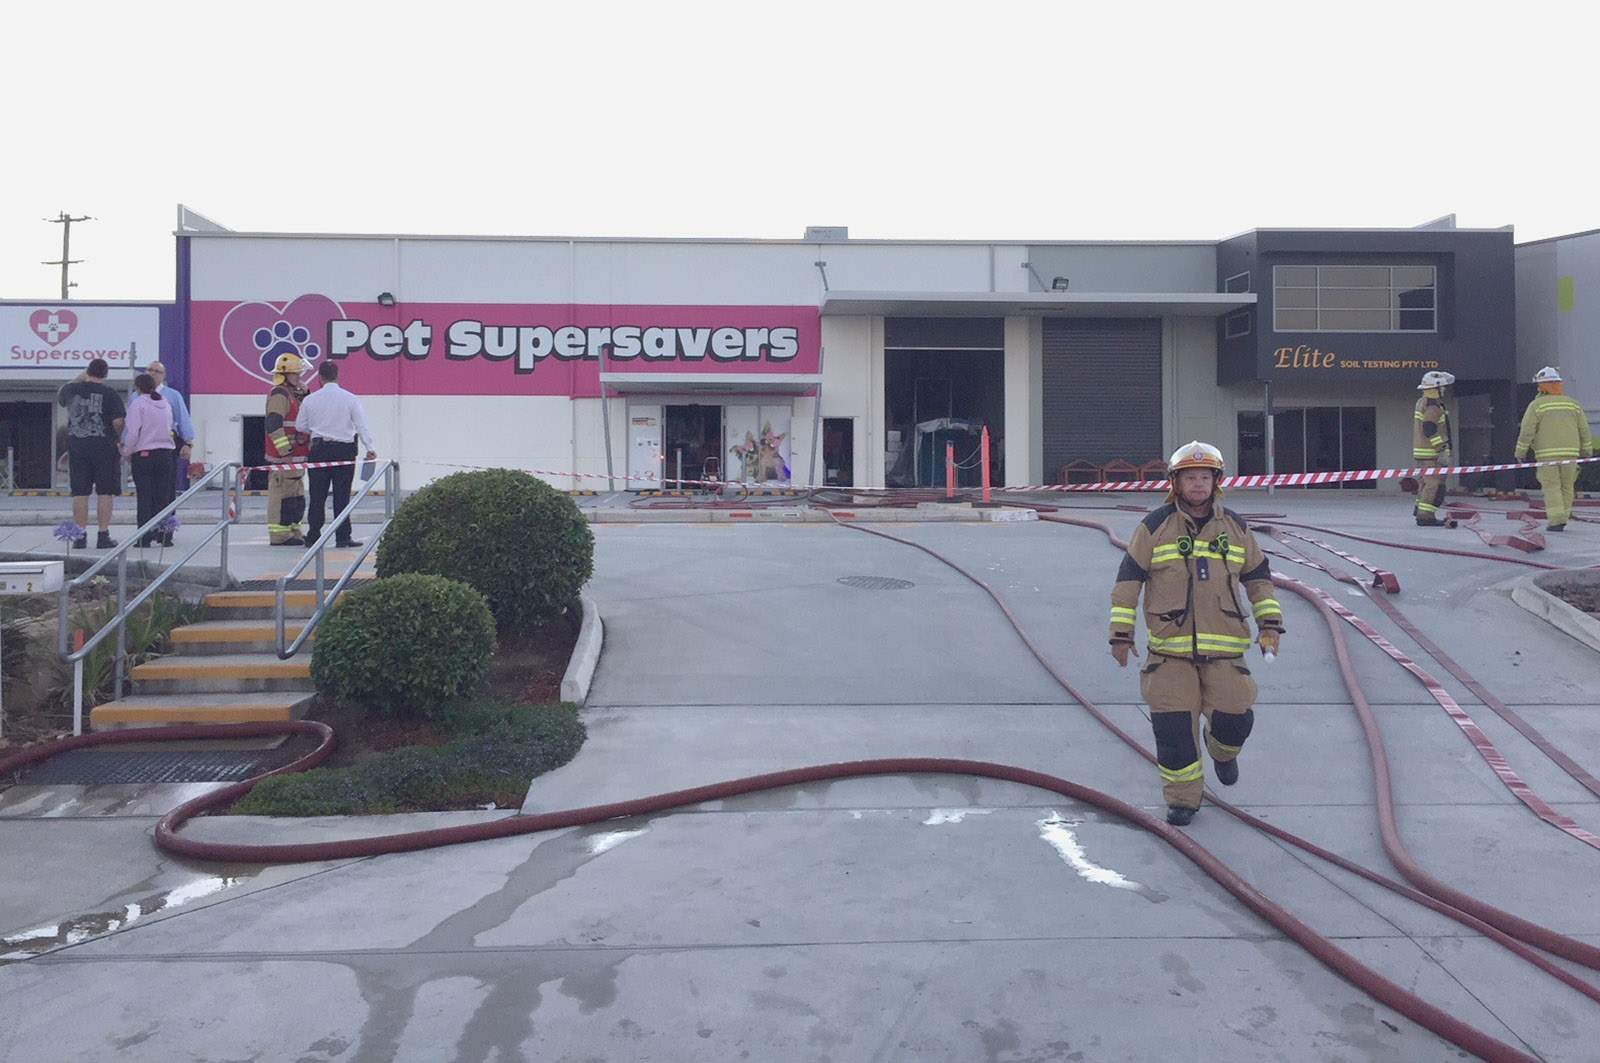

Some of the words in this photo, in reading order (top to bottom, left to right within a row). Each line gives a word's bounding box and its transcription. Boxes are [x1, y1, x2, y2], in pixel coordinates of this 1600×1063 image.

[329, 319, 432, 359] Pet
[446, 320, 799, 374] Supersavers
[1273, 344, 1336, 368] Elite
[1340, 360, 1361, 369] SOIL
[1362, 360, 1401, 369] TESTING
[1402, 360, 1420, 369] PTY
[1421, 360, 1439, 369] LTD
